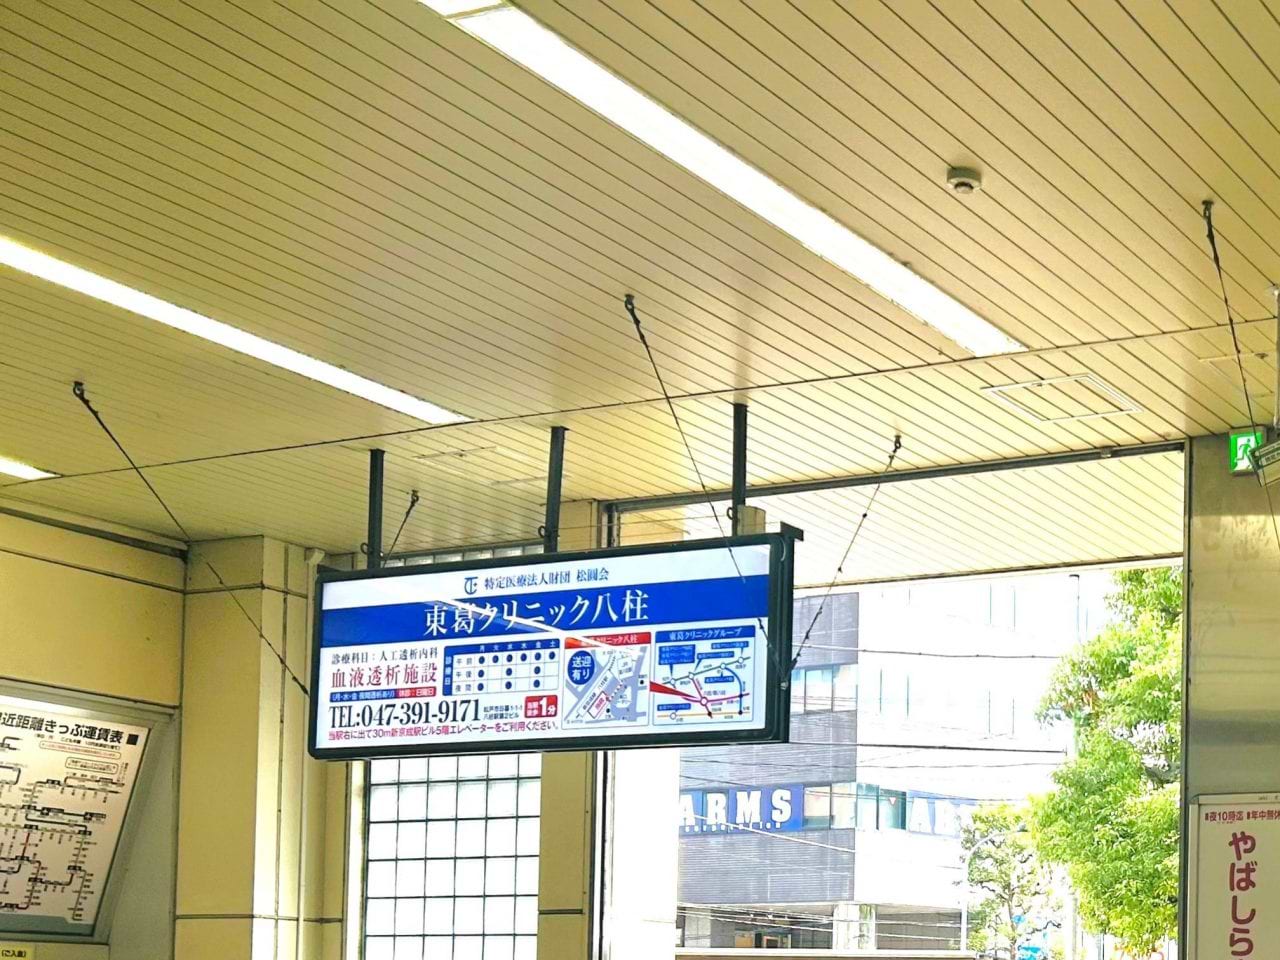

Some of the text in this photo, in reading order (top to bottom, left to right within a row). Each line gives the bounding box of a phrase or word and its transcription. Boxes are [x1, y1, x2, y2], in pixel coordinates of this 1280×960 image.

[423, 589, 650, 637] 東葛クリニック八柱
[331, 663, 438, 688] 血液透析施設
[328, 699, 480, 729] TEL:047-391-9171
